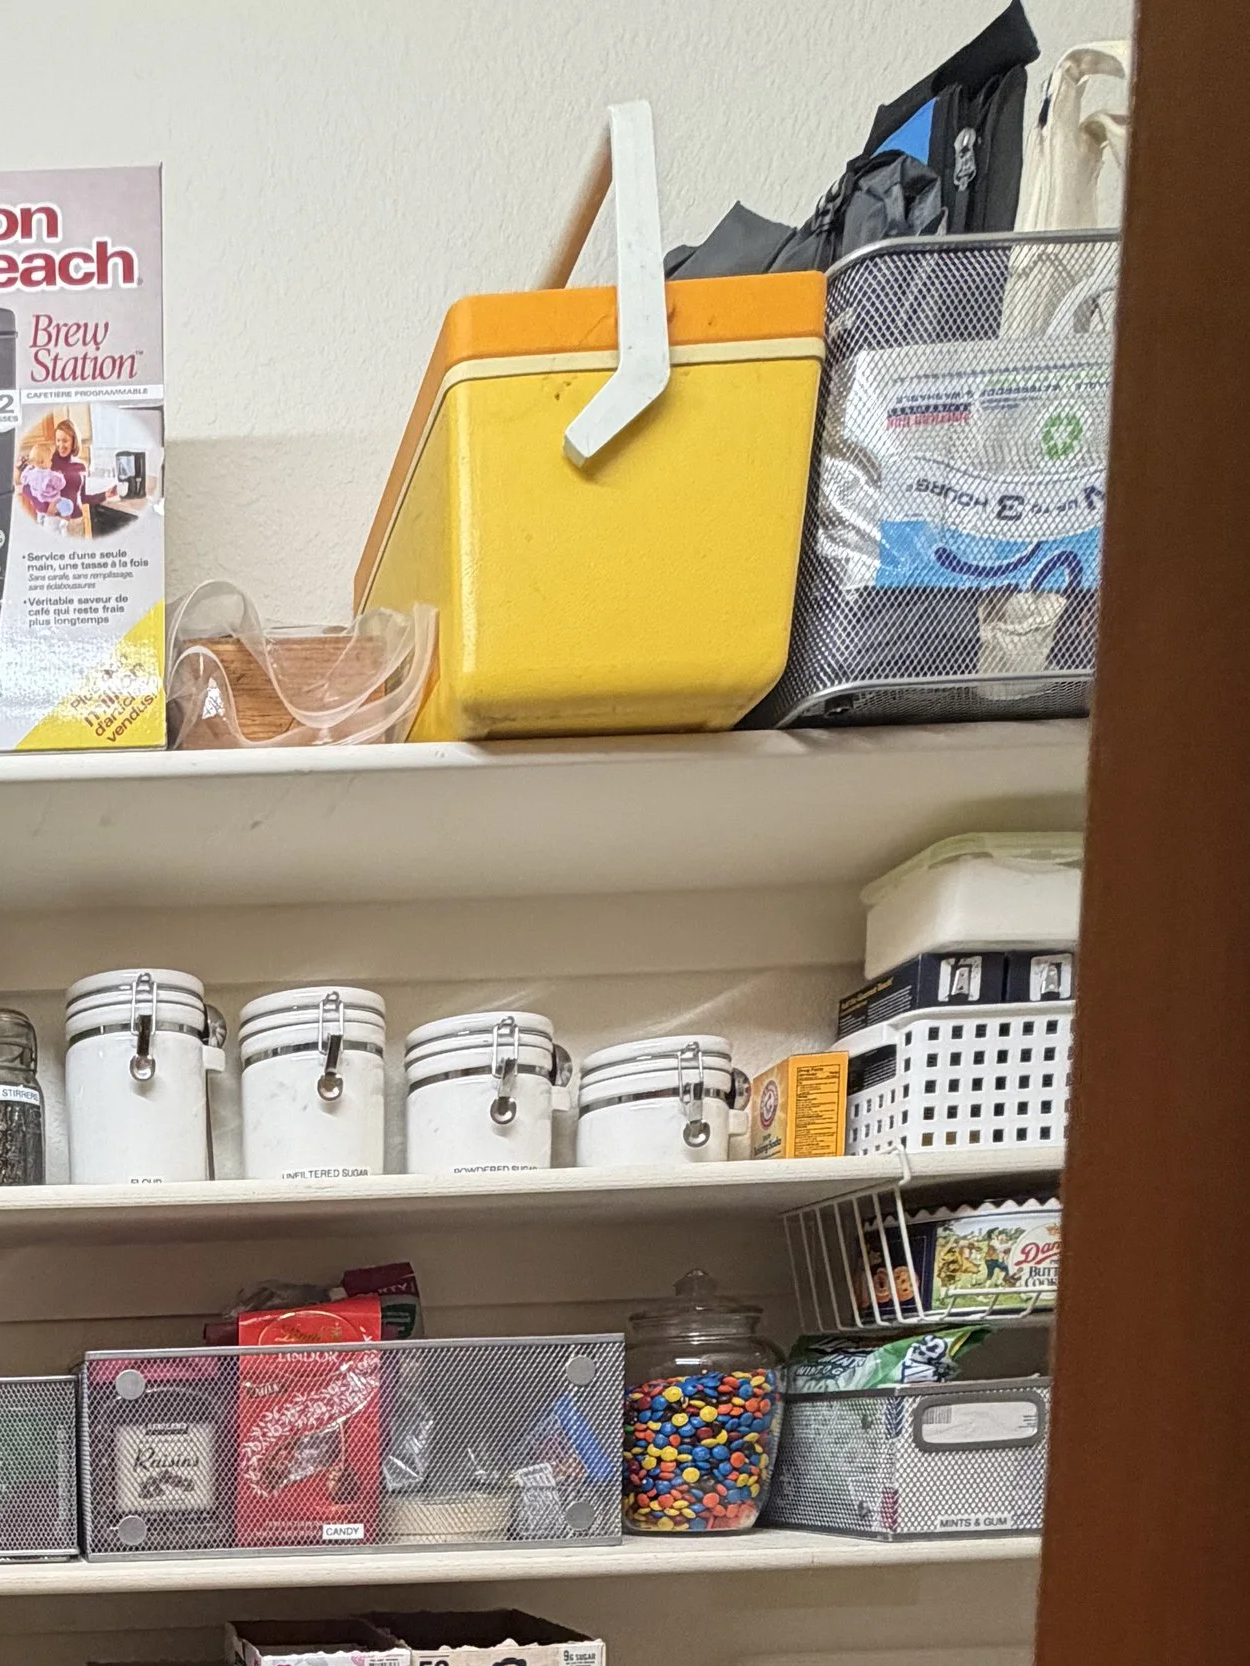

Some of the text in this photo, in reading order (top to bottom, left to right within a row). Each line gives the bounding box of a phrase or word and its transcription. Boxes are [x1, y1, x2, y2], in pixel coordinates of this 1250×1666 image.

[29, 314, 109, 349] Brew
[30, 348, 138, 383] Station
[74, 387, 149, 397] PROGRAMMABLE
[915, 478, 989, 511] HOURS
[27, 549, 127, 562] Service d'une seule
[27, 562, 56, 572] main,
[59, 563, 78, 571] une
[81, 561, 108, 570] tasse
[119, 558, 128, 568] la
[130, 558, 149, 567] fois
[28, 594, 128, 607] Véritable saveur de
[28, 604, 125, 617] café qui reste frais
[29, 616, 110, 628] plus longtemps
[2, 1088, 39, 1102] STIRRERS
[342, 1168, 369, 1178] SUGAR
[1014, 1241, 1061, 1267] Dan
[132, 1447, 200, 1473] Raisins
[939, 1516, 1008, 1528] MINTS & GUM
[325, 1526, 360, 1537] CANDY
[575, 1652, 596, 1661] SUGAR
